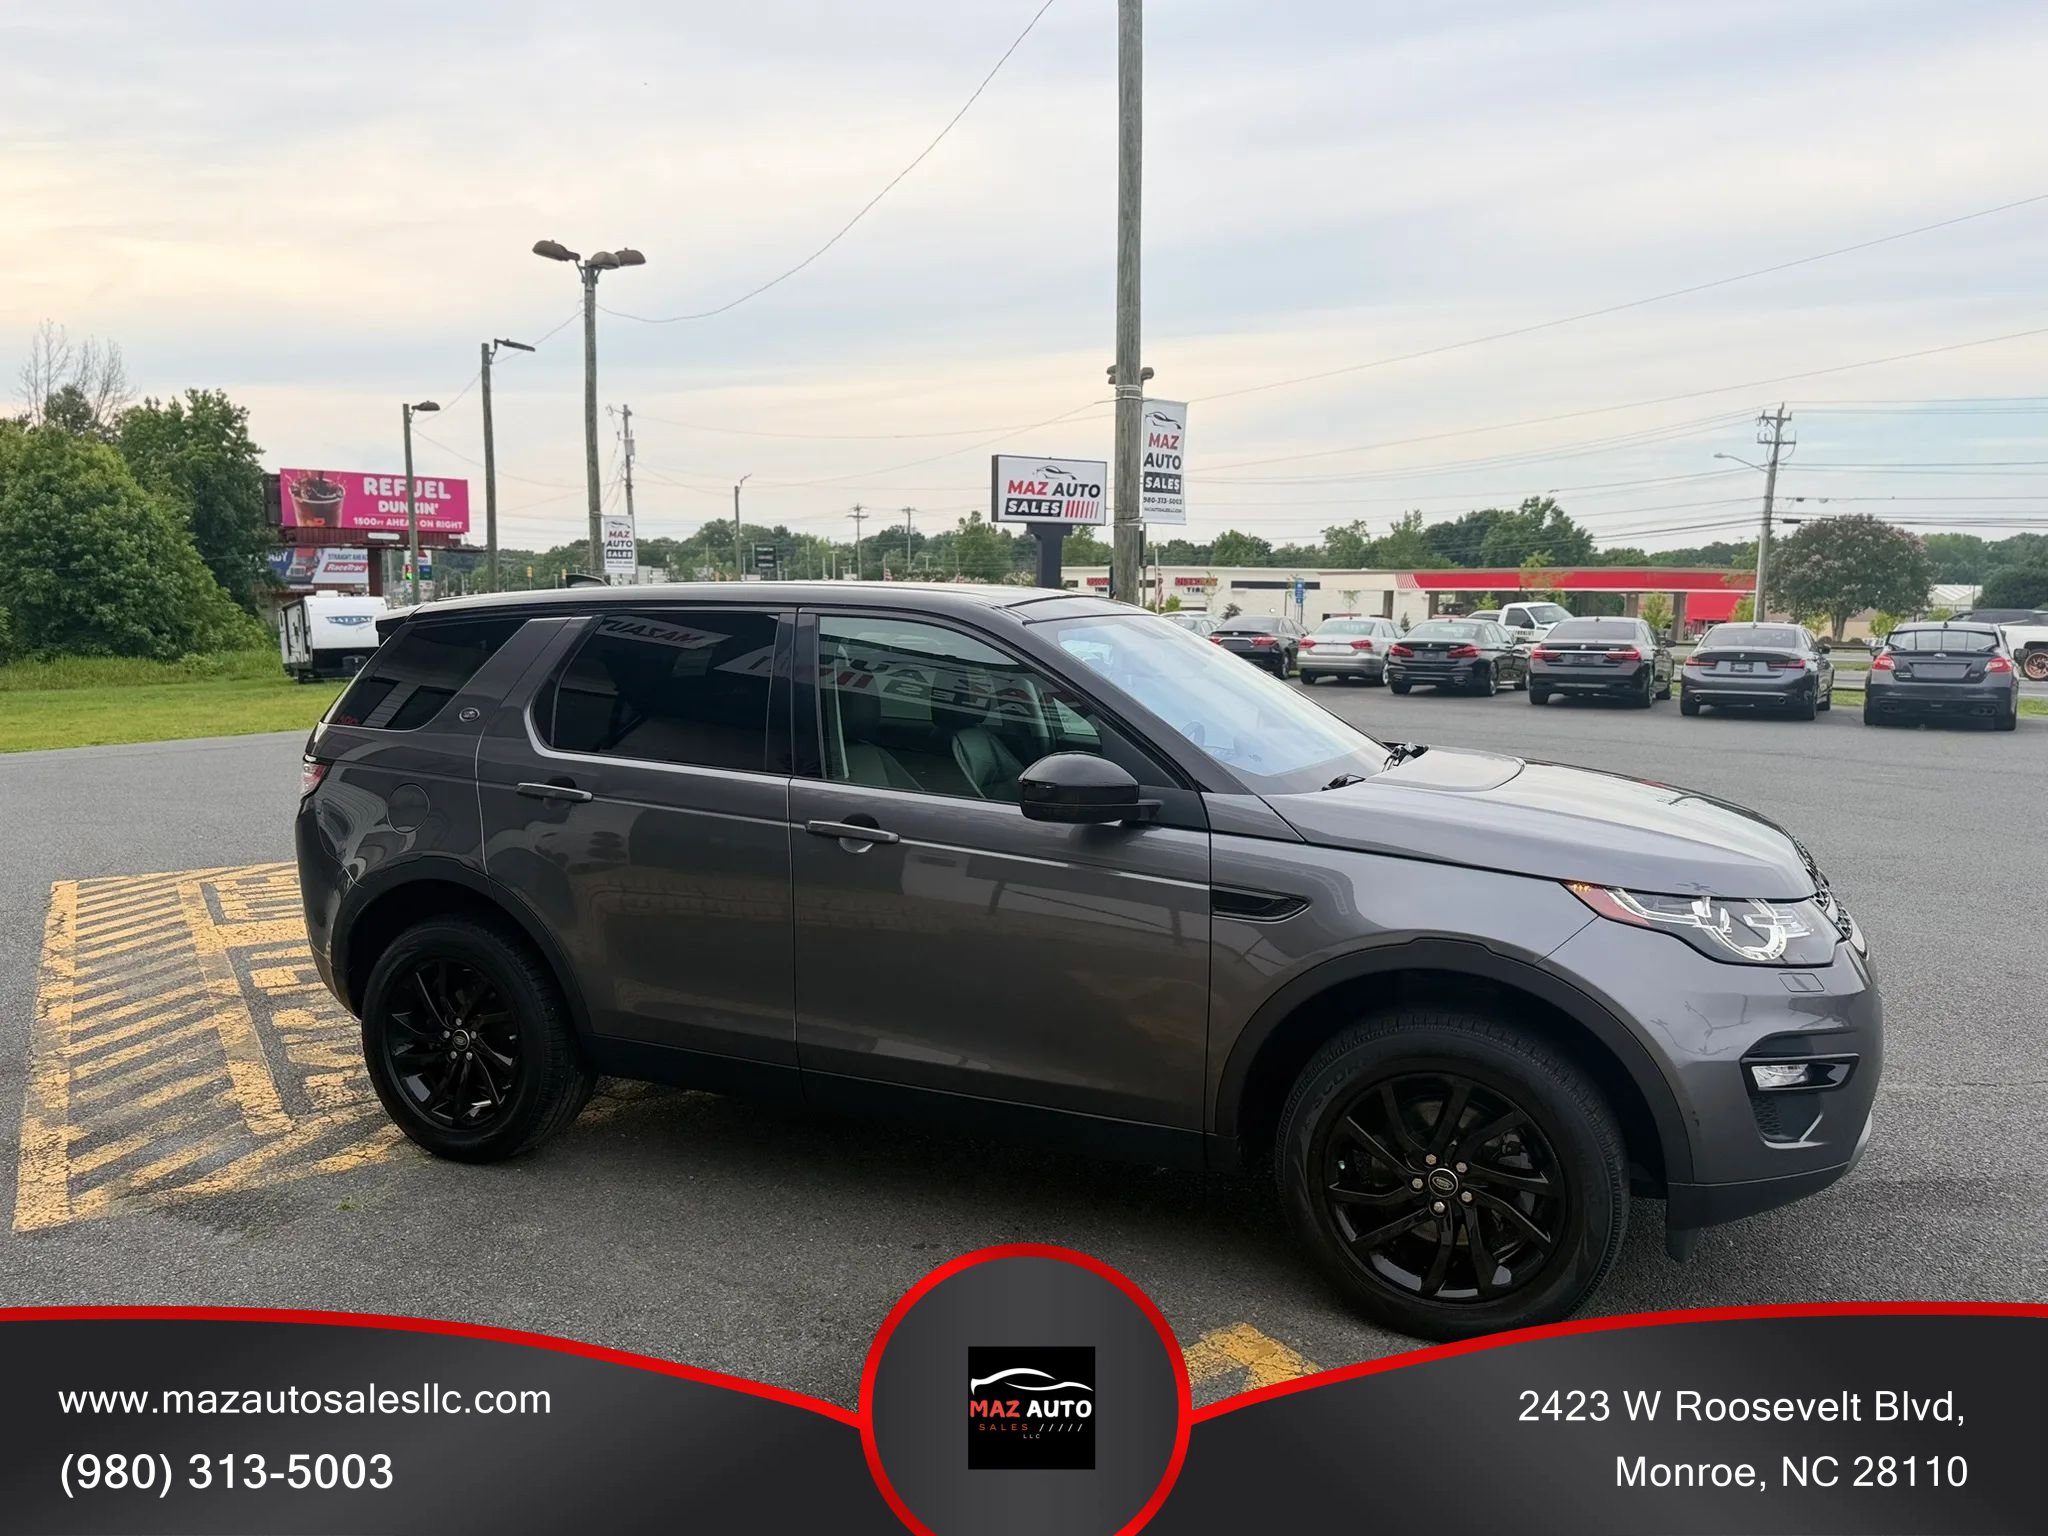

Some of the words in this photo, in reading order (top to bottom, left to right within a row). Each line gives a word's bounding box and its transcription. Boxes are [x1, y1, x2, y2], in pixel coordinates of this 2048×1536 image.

[1149, 433, 1179, 450] MAZ
[1144, 453, 1181, 470] AUTO
[1007, 480, 1049, 496] MAZ
[1052, 482, 1100, 498] AUTO
[1145, 476, 1180, 490] SALES
[1008, 500, 1061, 515] SALES
[386, 518, 417, 527] AHEA
[419, 519, 434, 528] ON
[436, 521, 463, 529] RIGHT
[608, 530, 630, 539] MAZ
[606, 540, 633, 548] AUTO
[607, 550, 632, 558] SALES
